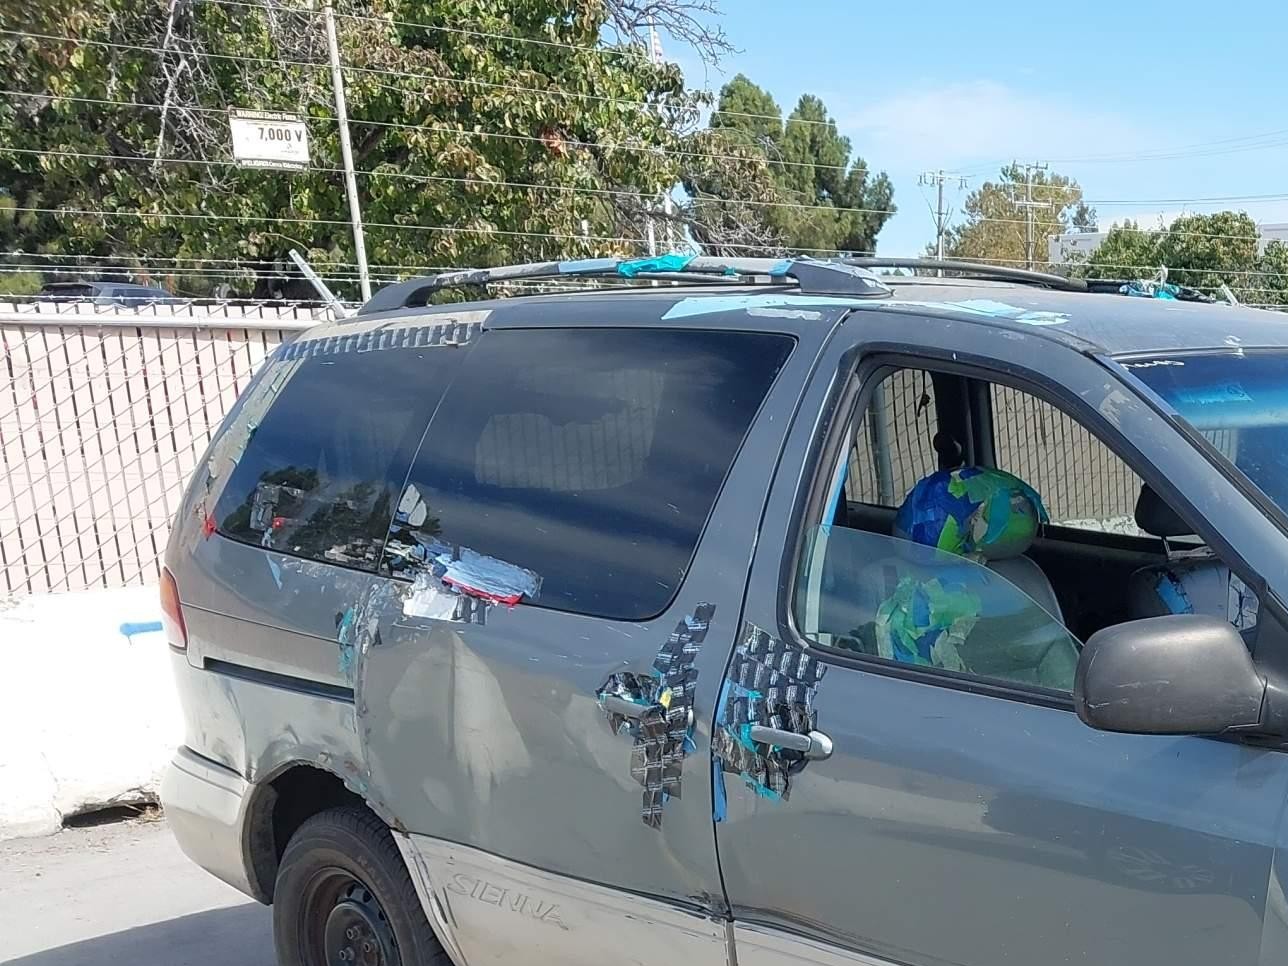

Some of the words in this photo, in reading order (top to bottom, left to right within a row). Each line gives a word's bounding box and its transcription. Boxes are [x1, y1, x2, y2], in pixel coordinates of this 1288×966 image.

[258, 127, 291, 142] 7,000
[295, 129, 302, 142] V
[446, 872, 569, 931] SIENNA
